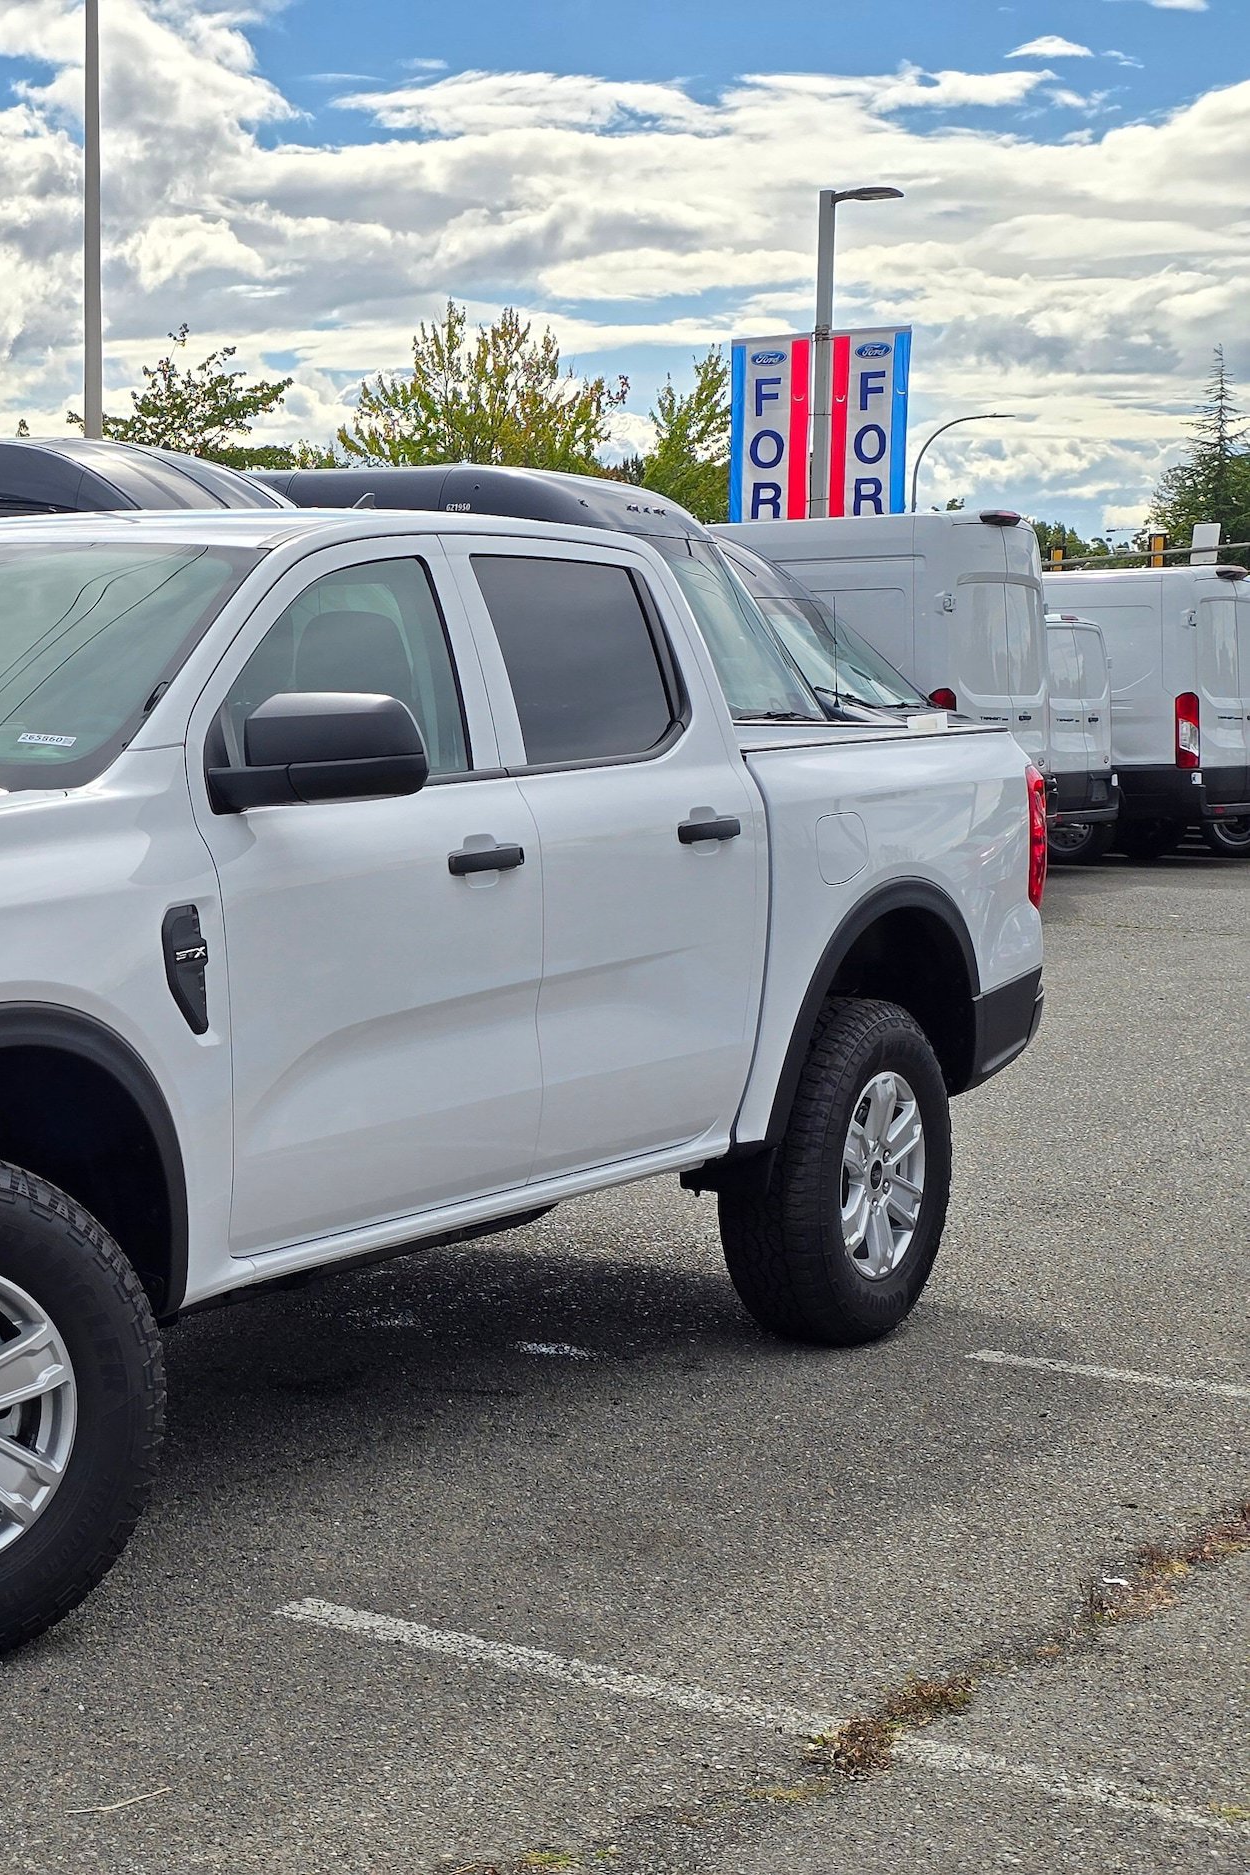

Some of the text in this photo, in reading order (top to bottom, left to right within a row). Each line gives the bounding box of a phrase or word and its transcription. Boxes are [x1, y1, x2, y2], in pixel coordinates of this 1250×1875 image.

[858, 345, 886, 357] Ford
[753, 353, 781, 365] Ford
[175, 946, 207, 962] STX
